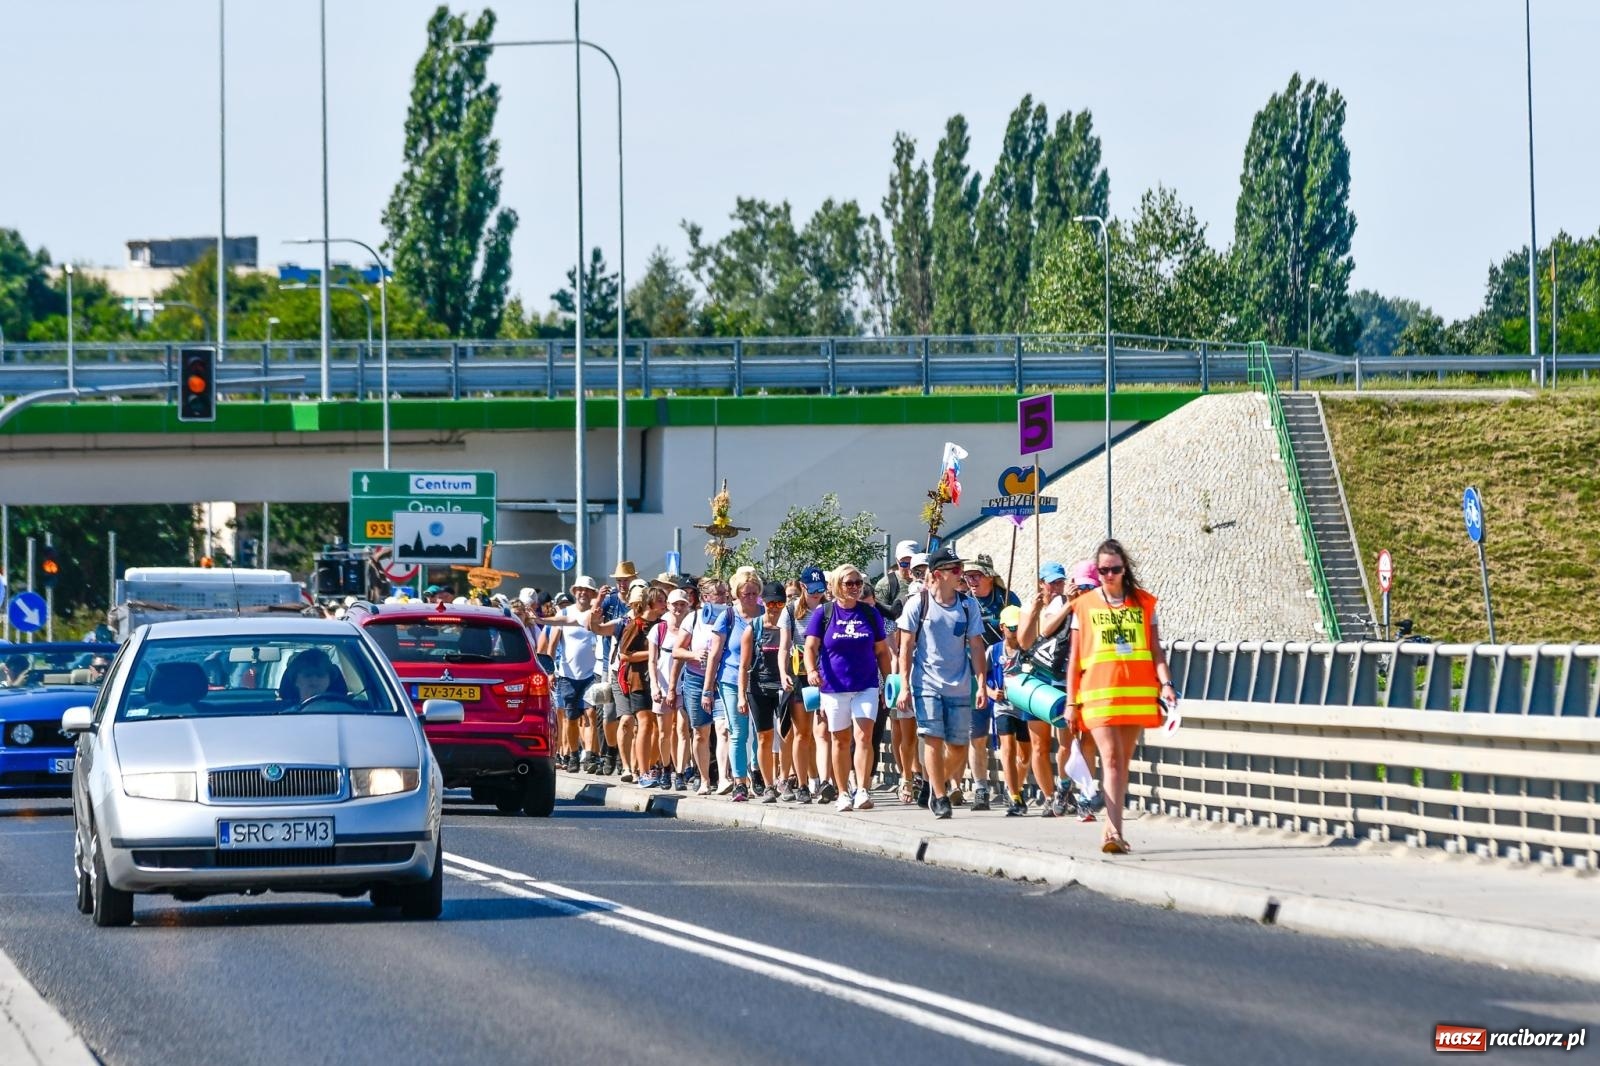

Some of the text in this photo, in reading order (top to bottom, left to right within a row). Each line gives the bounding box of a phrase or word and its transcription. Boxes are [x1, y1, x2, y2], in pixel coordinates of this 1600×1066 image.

[1024, 401, 1048, 448] 5
[414, 478, 472, 490] Centrum
[370, 523, 394, 536] 935
[1101, 628, 1137, 645] RUCEM
[423, 687, 476, 699] ZV-374-B
[233, 822, 329, 843] SRC 3FM3
